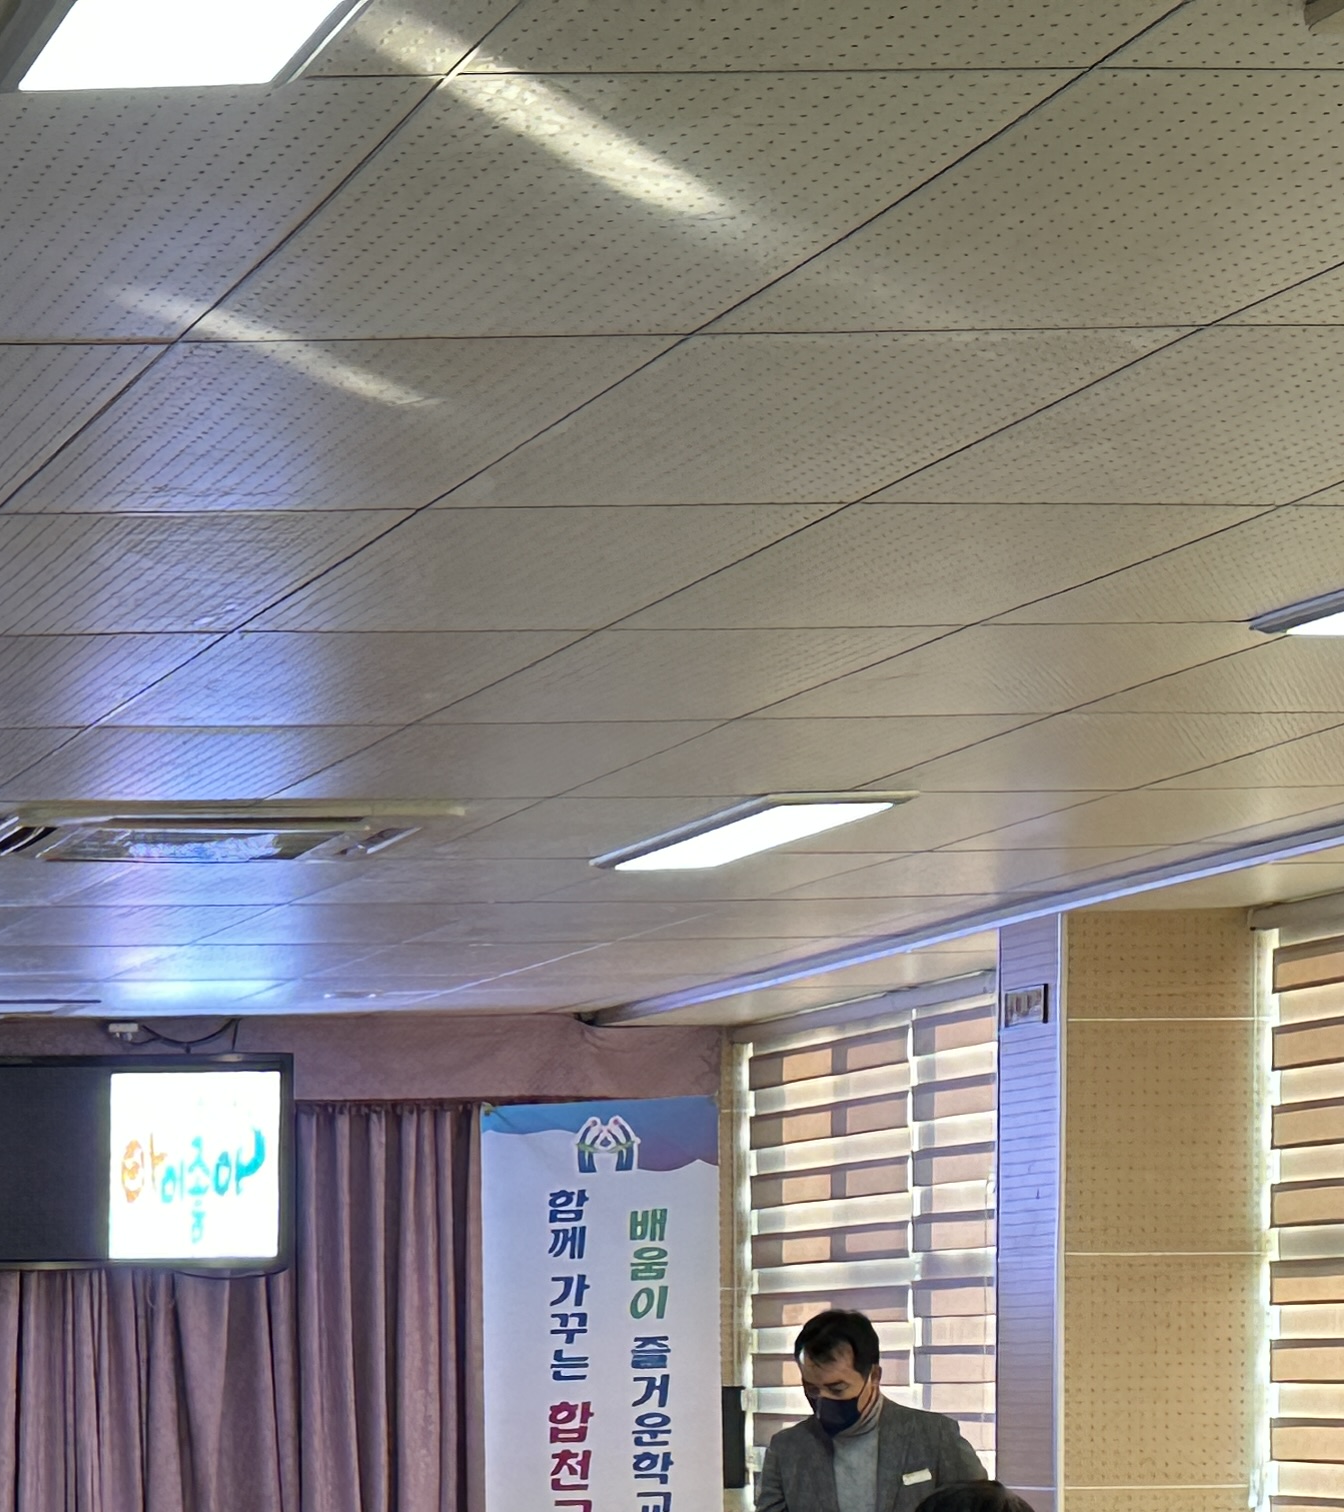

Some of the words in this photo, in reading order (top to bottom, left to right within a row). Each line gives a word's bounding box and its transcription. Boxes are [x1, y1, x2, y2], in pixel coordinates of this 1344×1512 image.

[547, 1189, 590, 1261] 함께
[628, 1208, 669, 1321] 배움이
[549, 1274, 591, 1382] 가꾸는
